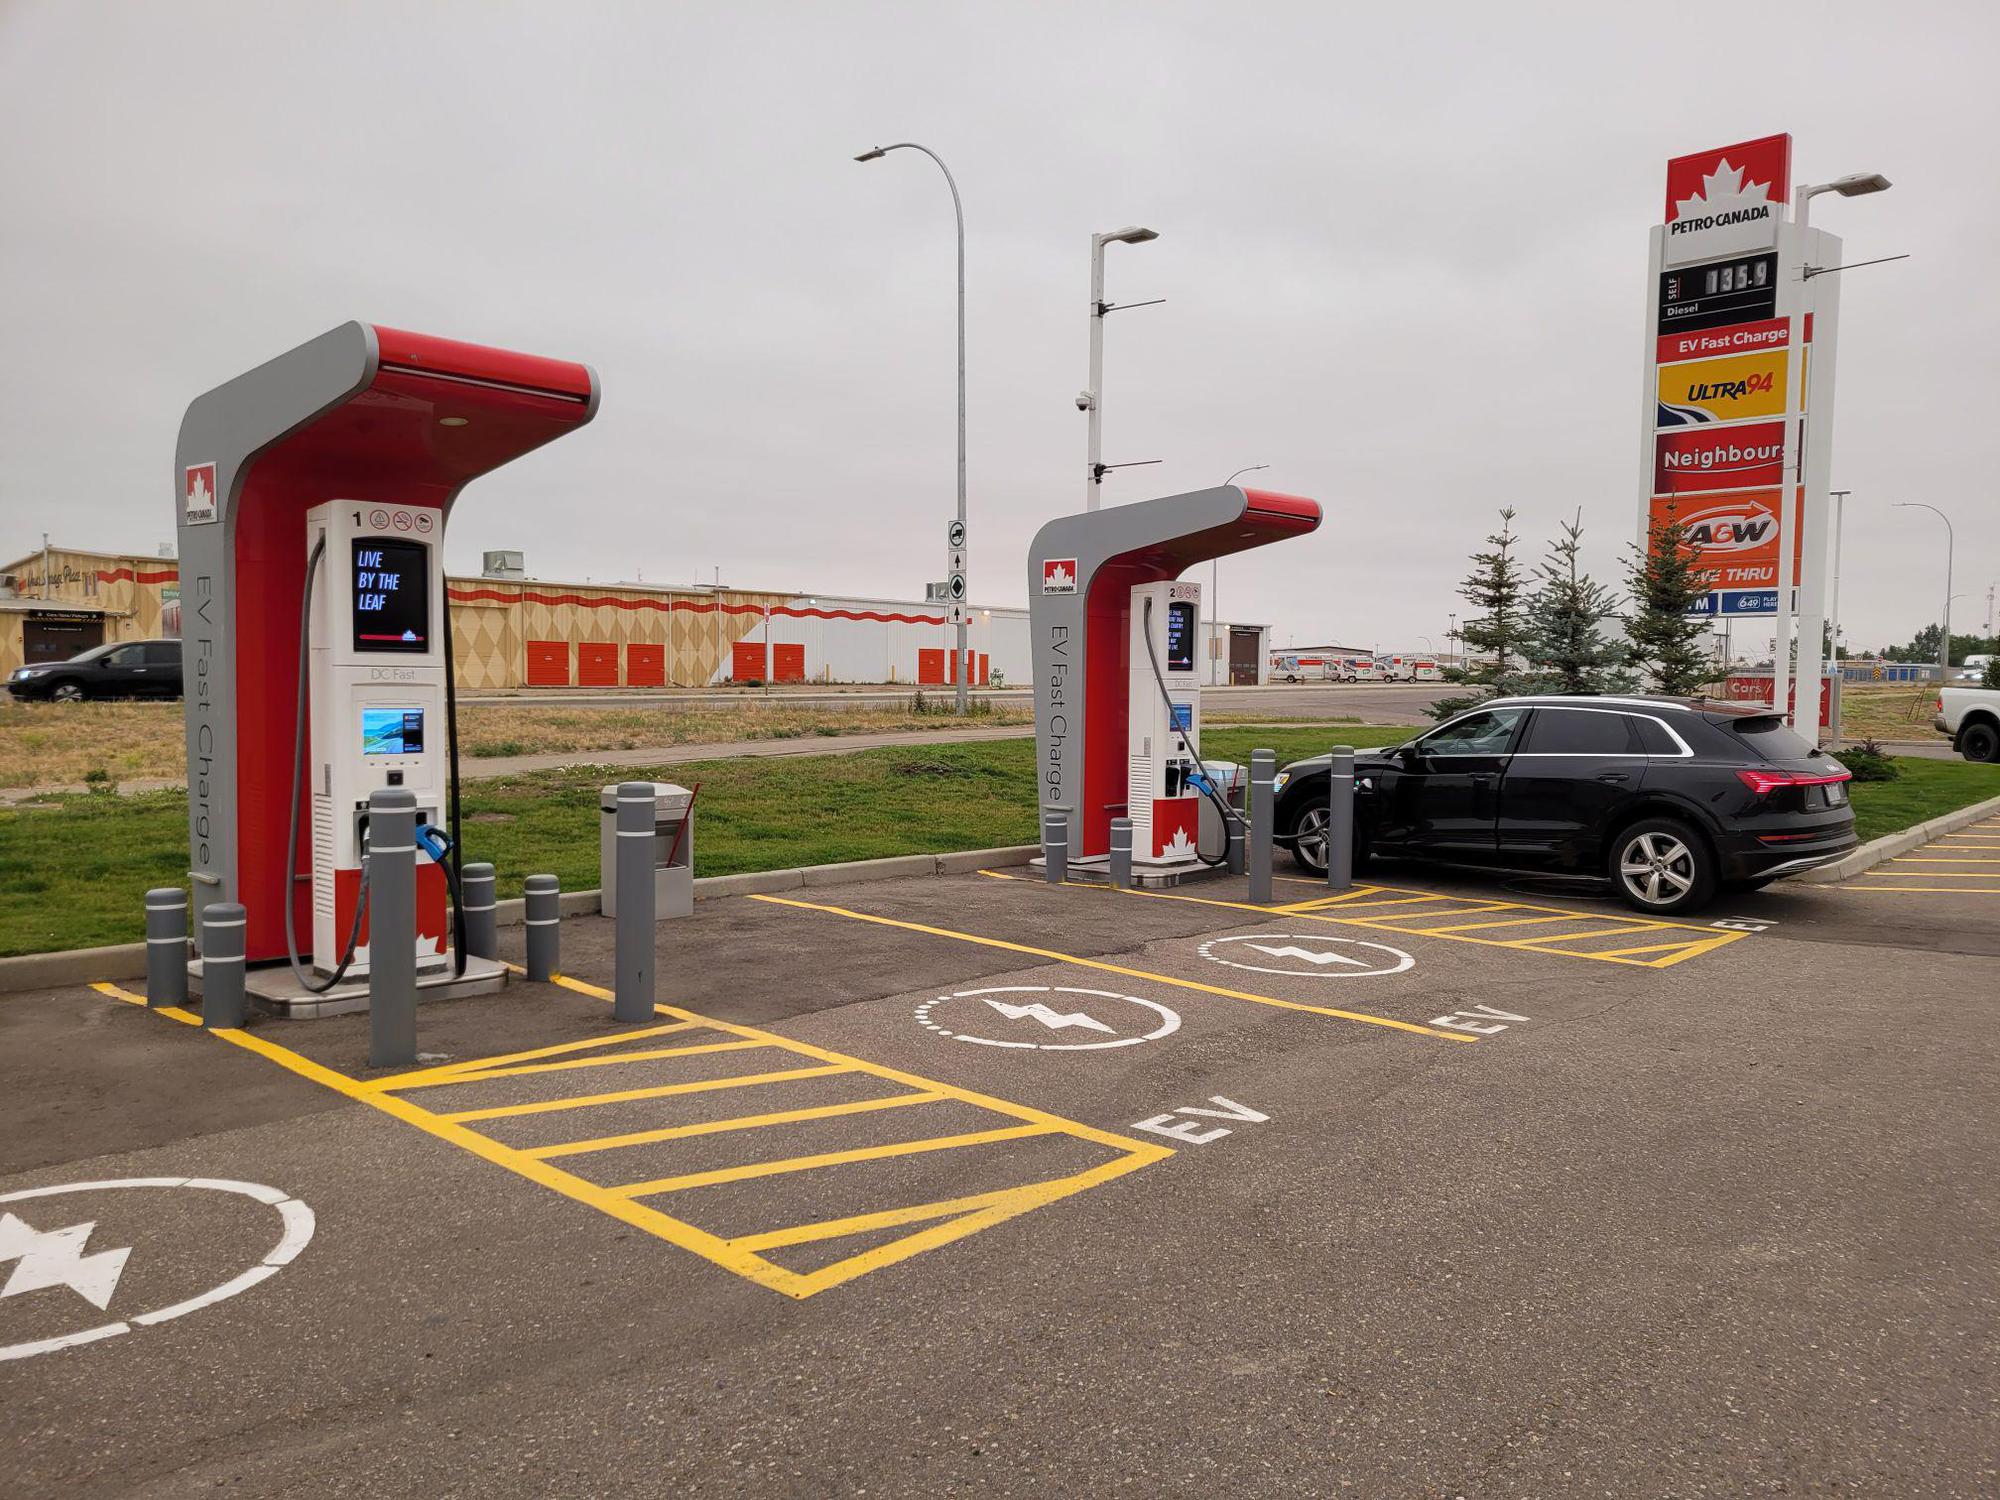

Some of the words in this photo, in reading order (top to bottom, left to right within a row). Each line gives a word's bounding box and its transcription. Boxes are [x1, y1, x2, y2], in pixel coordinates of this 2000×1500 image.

[1668, 278, 1677, 300] SELF
[1667, 303, 1698, 316] Diesel
[1679, 339, 1698, 352] EV
[1701, 335, 1730, 349] Fast
[1733, 329, 1788, 344] Charge
[352, 511, 361, 527] 1
[1686, 519, 1771, 544] A&W
[358, 551, 382, 567] LIVE
[358, 573, 373, 588] BY
[379, 573, 400, 590] THE
[1726, 567, 1773, 581] THRU
[196, 576, 212, 625] EV
[358, 594, 386, 611] LEAF
[1169, 587, 1176, 598] 2
[1051, 626, 1068, 656] EV
[198, 639, 212, 712] Fast
[371, 668, 390, 680] DC
[393, 668, 415, 680] Fast
[1051, 664, 1067, 708] Fast
[1731, 683, 1761, 694] Cars
[1046, 715, 1067, 801] Charge
[195, 725, 213, 865] Charge
[1710, 915, 1779, 932] EV
[1429, 1004, 1531, 1035] EV
[1130, 1095, 1271, 1145] EV
